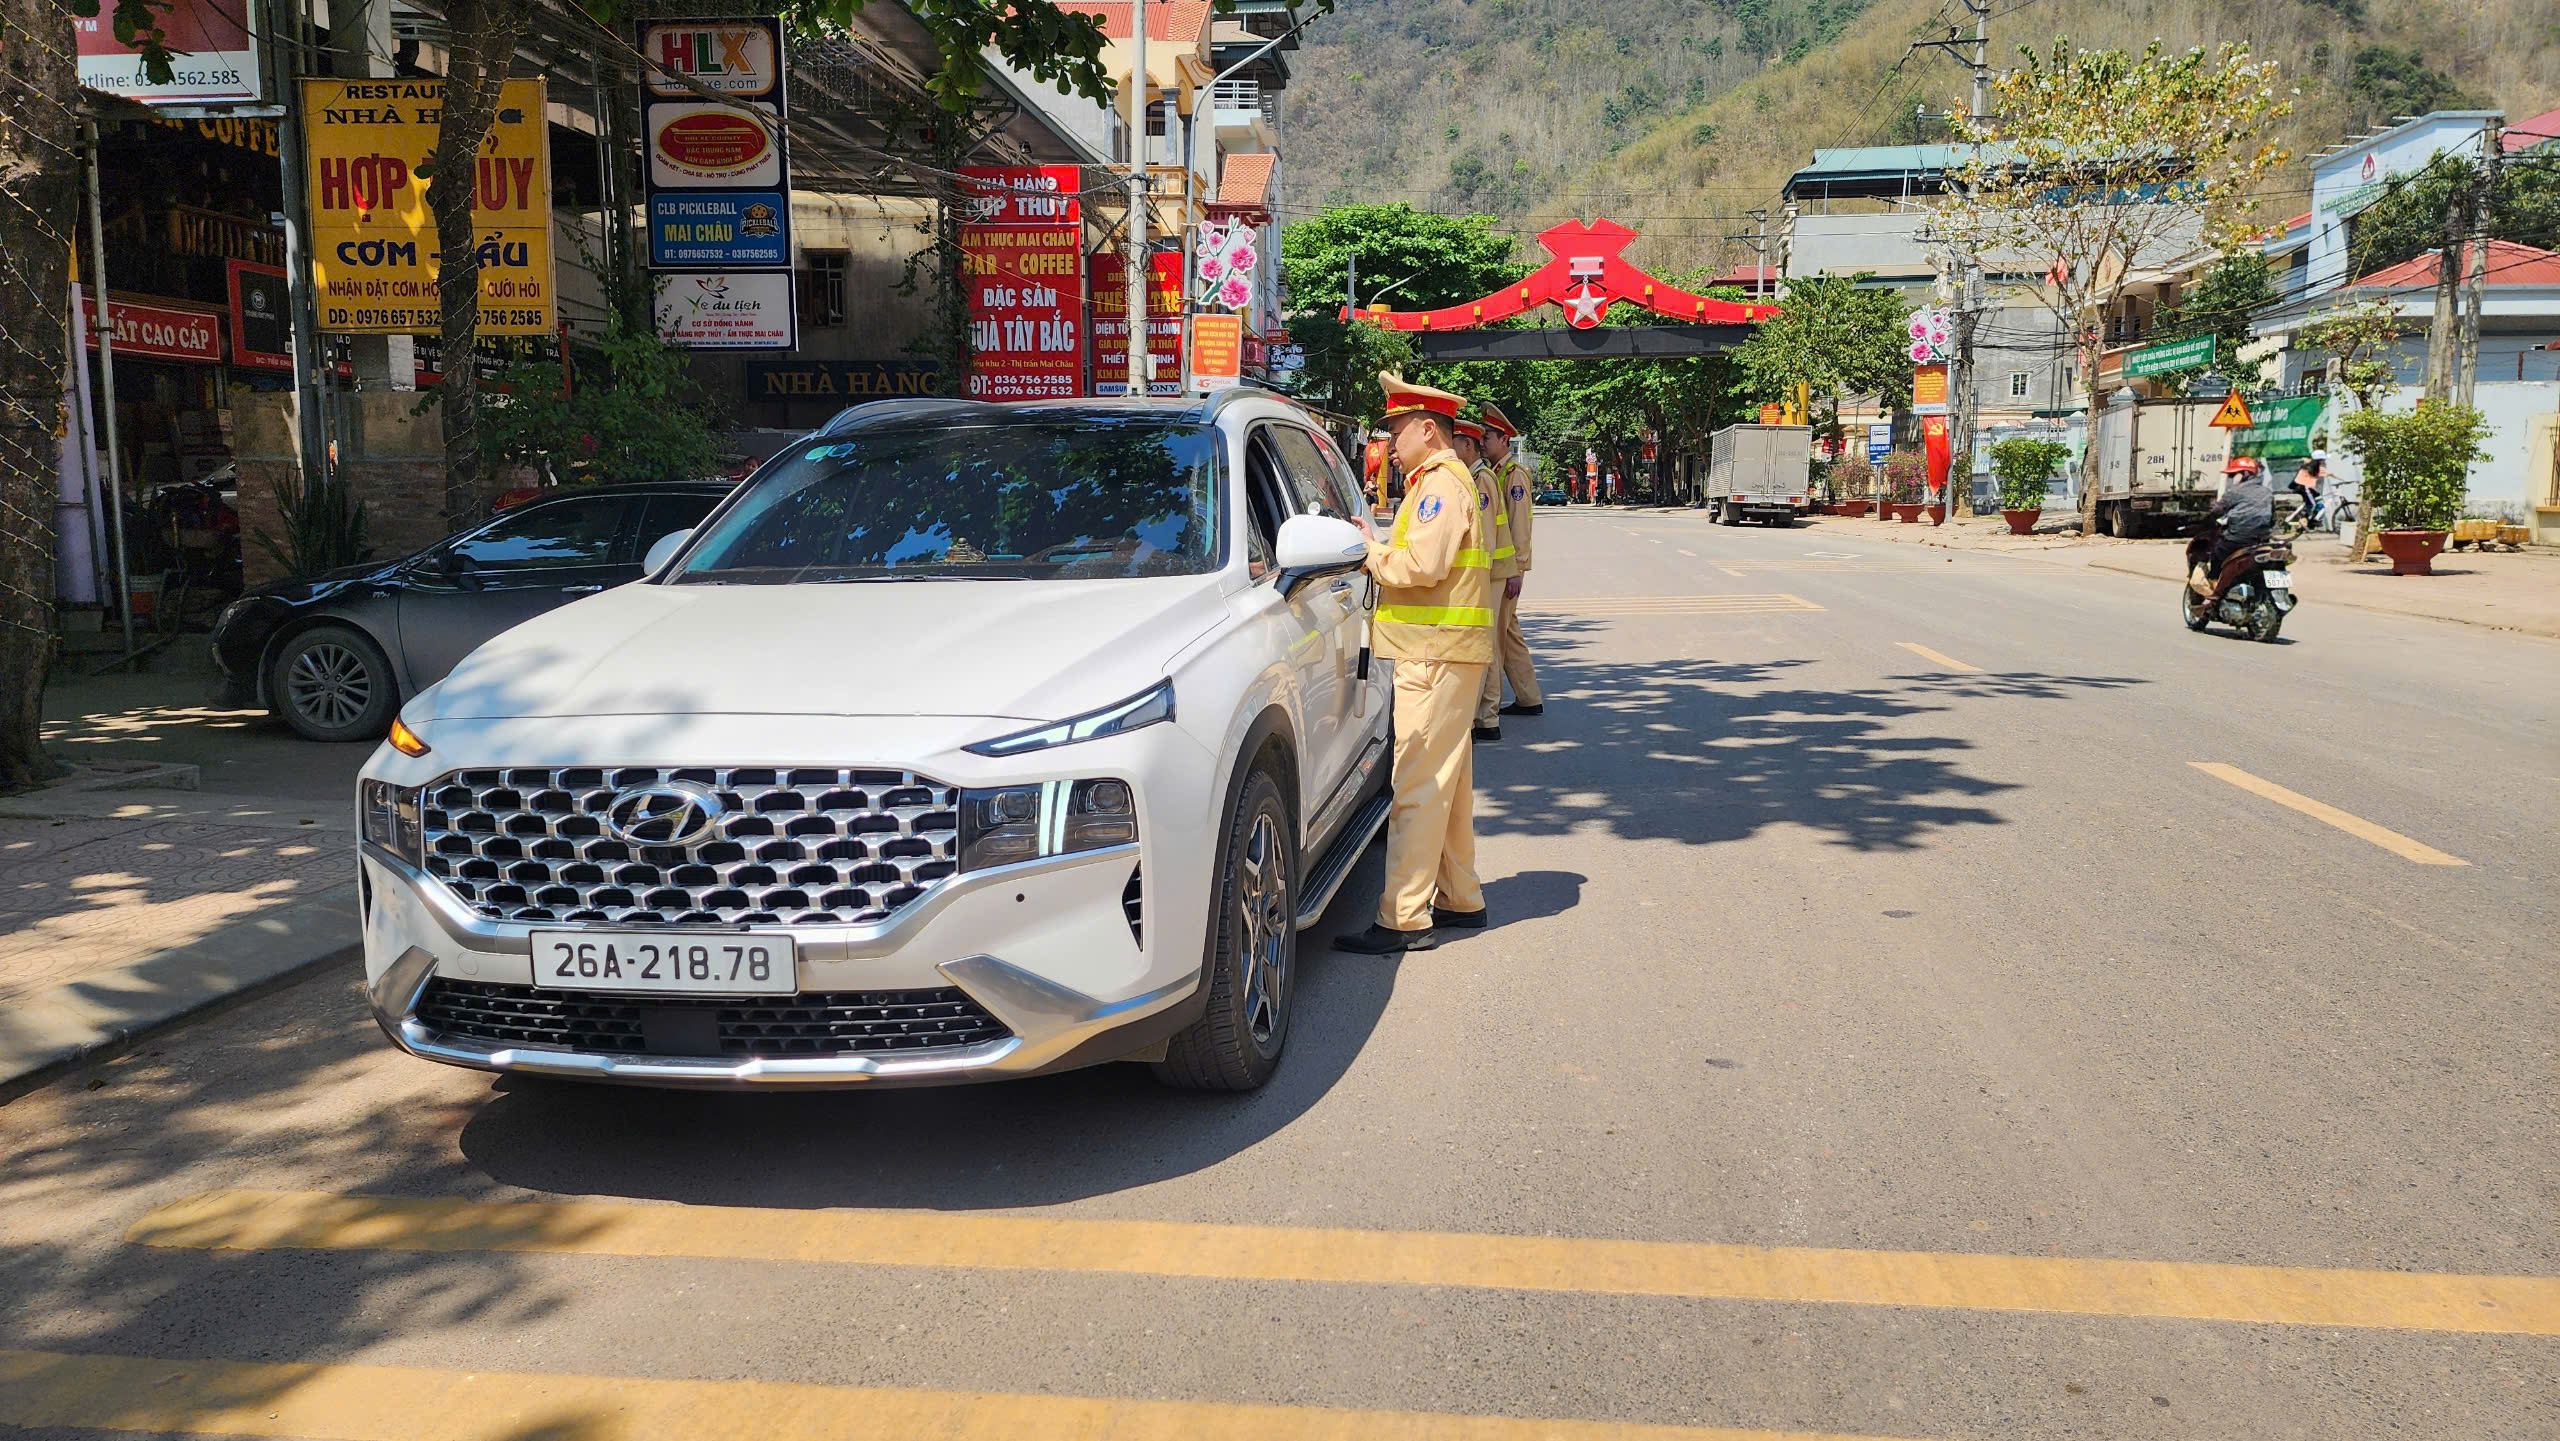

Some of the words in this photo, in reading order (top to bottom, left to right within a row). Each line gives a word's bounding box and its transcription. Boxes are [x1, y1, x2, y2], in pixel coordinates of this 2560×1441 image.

[74, 20, 97, 32] YM
[661, 32, 755, 76] HLX
[79, 73, 129, 88] otline:
[323, 104, 404, 124] NHÀ
[320, 153, 407, 222] HỢP
[976, 173, 1007, 190] NHÀ
[1013, 173, 1058, 190] HÀNG
[658, 202, 676, 215] CLB
[679, 202, 737, 215] PICKLEBALL
[665, 224, 691, 241] MAI
[696, 220, 733, 241] CHÂU
[1016, 232, 1040, 247] MAI
[1042, 229, 1075, 246] CHÂU
[337, 239, 416, 266] CƠM
[475, 232, 528, 269] ẨU
[962, 253, 998, 275] BAR
[1019, 252, 1074, 275] COFFEE
[328, 278, 363, 301] NHẬN
[366, 278, 388, 301] ĐẶT
[392, 281, 419, 297] CƠM
[487, 279, 515, 298] CƯỚI
[519, 276, 540, 298] HỎI
[983, 283, 1016, 311] ĐẶC
[1021, 282, 1057, 307] SẢN
[712, 300, 730, 310] du
[734, 300, 761, 312] lịch
[356, 310, 387, 325] 0976
[390, 310, 414, 325] 657
[483, 310, 506, 325] 756
[510, 310, 542, 325] 2585
[142, 322, 175, 346] CAO
[178, 318, 210, 350] CẤP
[754, 330, 766, 338] MAI
[1004, 315, 1034, 352] TÂY
[1039, 309, 1075, 352] BẮC
[1095, 320, 1115, 337] ĐIỆN
[1158, 322, 1180, 336] LẠNH
[1098, 340, 1112, 349] GIA
[1158, 337, 1177, 349] THẤT
[985, 360, 1000, 368] khu
[1001, 360, 1006, 368] 2
[1040, 360, 1054, 368] Mai
[1055, 359, 1074, 368] Châu
[1101, 351, 1126, 364] THIẾT
[763, 364, 839, 394] NHÀ
[1096, 370, 1112, 379] KIM
[1157, 367, 1180, 379] NƯỚC
[969, 375, 992, 395] ĐT:
[994, 375, 1018, 384] 036
[1020, 375, 1041, 384] 756
[1043, 375, 1073, 384] 2585
[994, 386, 1023, 395] 0976
[1026, 386, 1048, 395] 657
[1050, 386, 1073, 395] 532
[1099, 385, 1127, 393] SAMSUN
[2147, 455, 2165, 465] 28H
[553, 942, 770, 982] 26A-218.78
